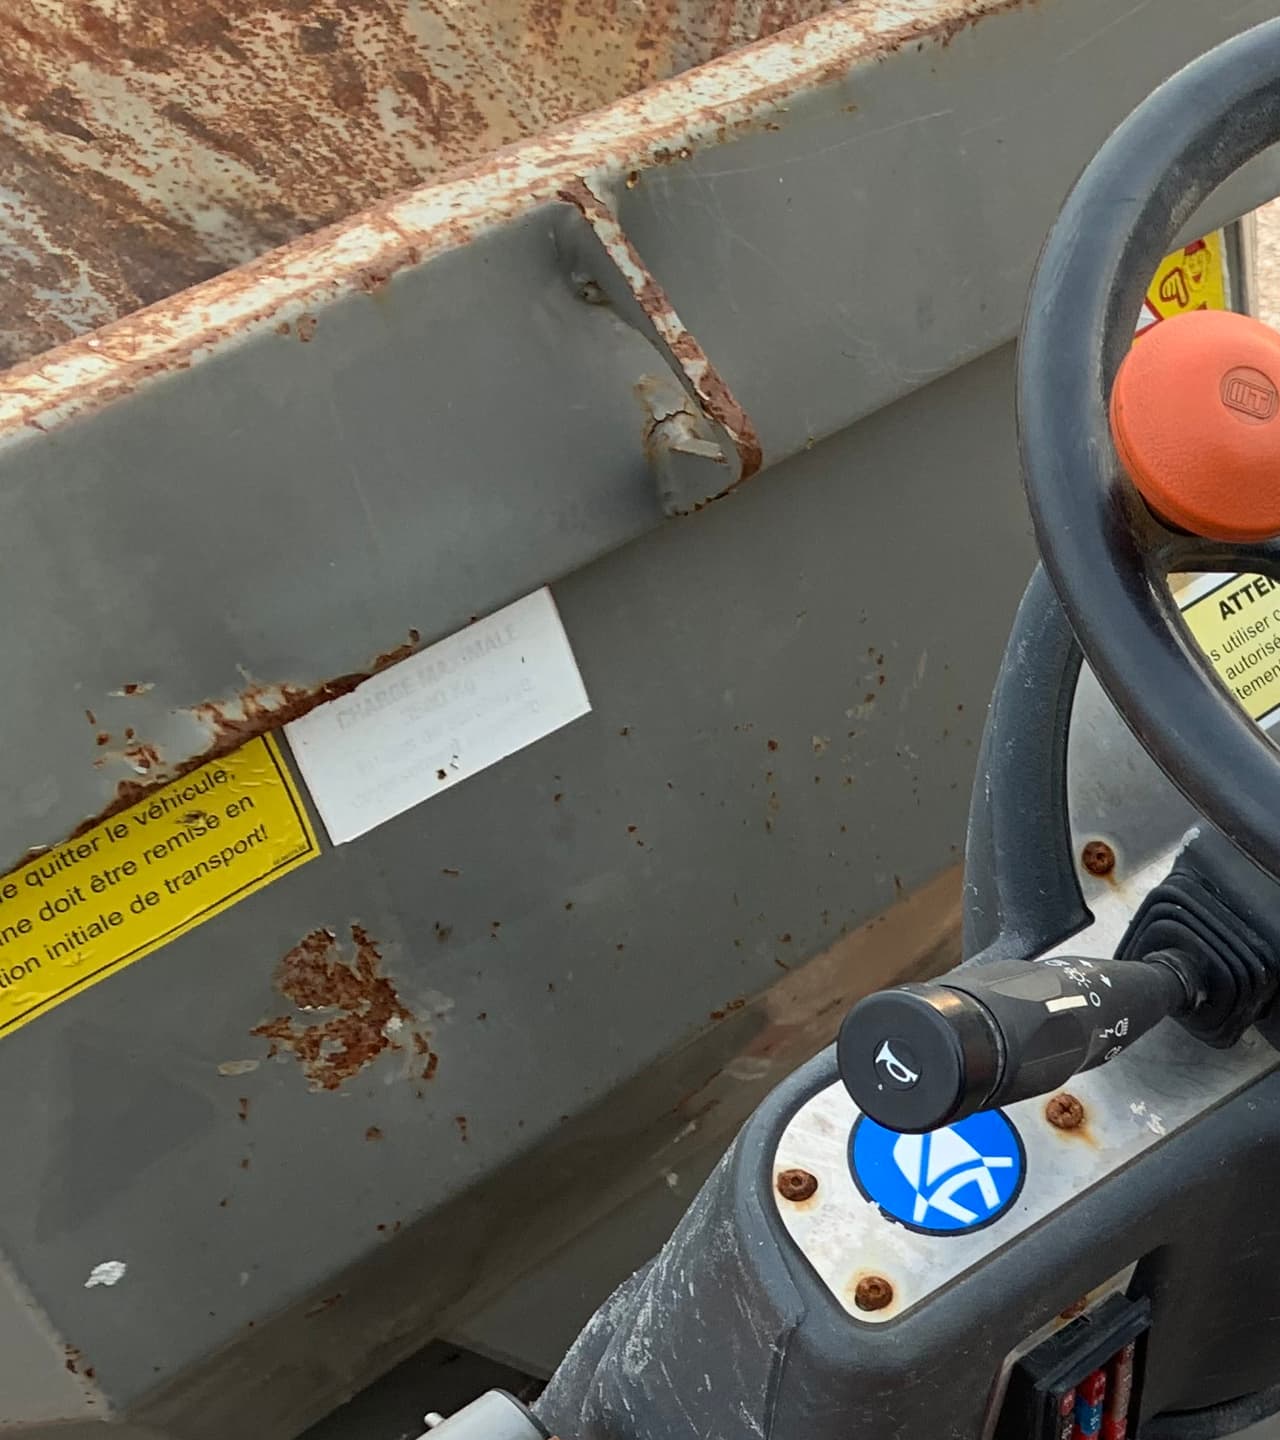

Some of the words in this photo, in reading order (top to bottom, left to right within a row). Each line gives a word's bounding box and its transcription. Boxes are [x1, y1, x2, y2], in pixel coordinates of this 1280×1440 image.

[1222, 616, 1271, 654] utiliser
[25, 837, 100, 887] quitter
[104, 823, 129, 843] le
[133, 769, 236, 825] véhicule,
[39, 886, 86, 921] doit
[90, 860, 138, 894] être
[142, 814, 220, 865] remise
[225, 796, 255, 819] en
[43, 910, 124, 961] initiale
[129, 890, 160, 914] de
[164, 824, 269, 894] transport!
